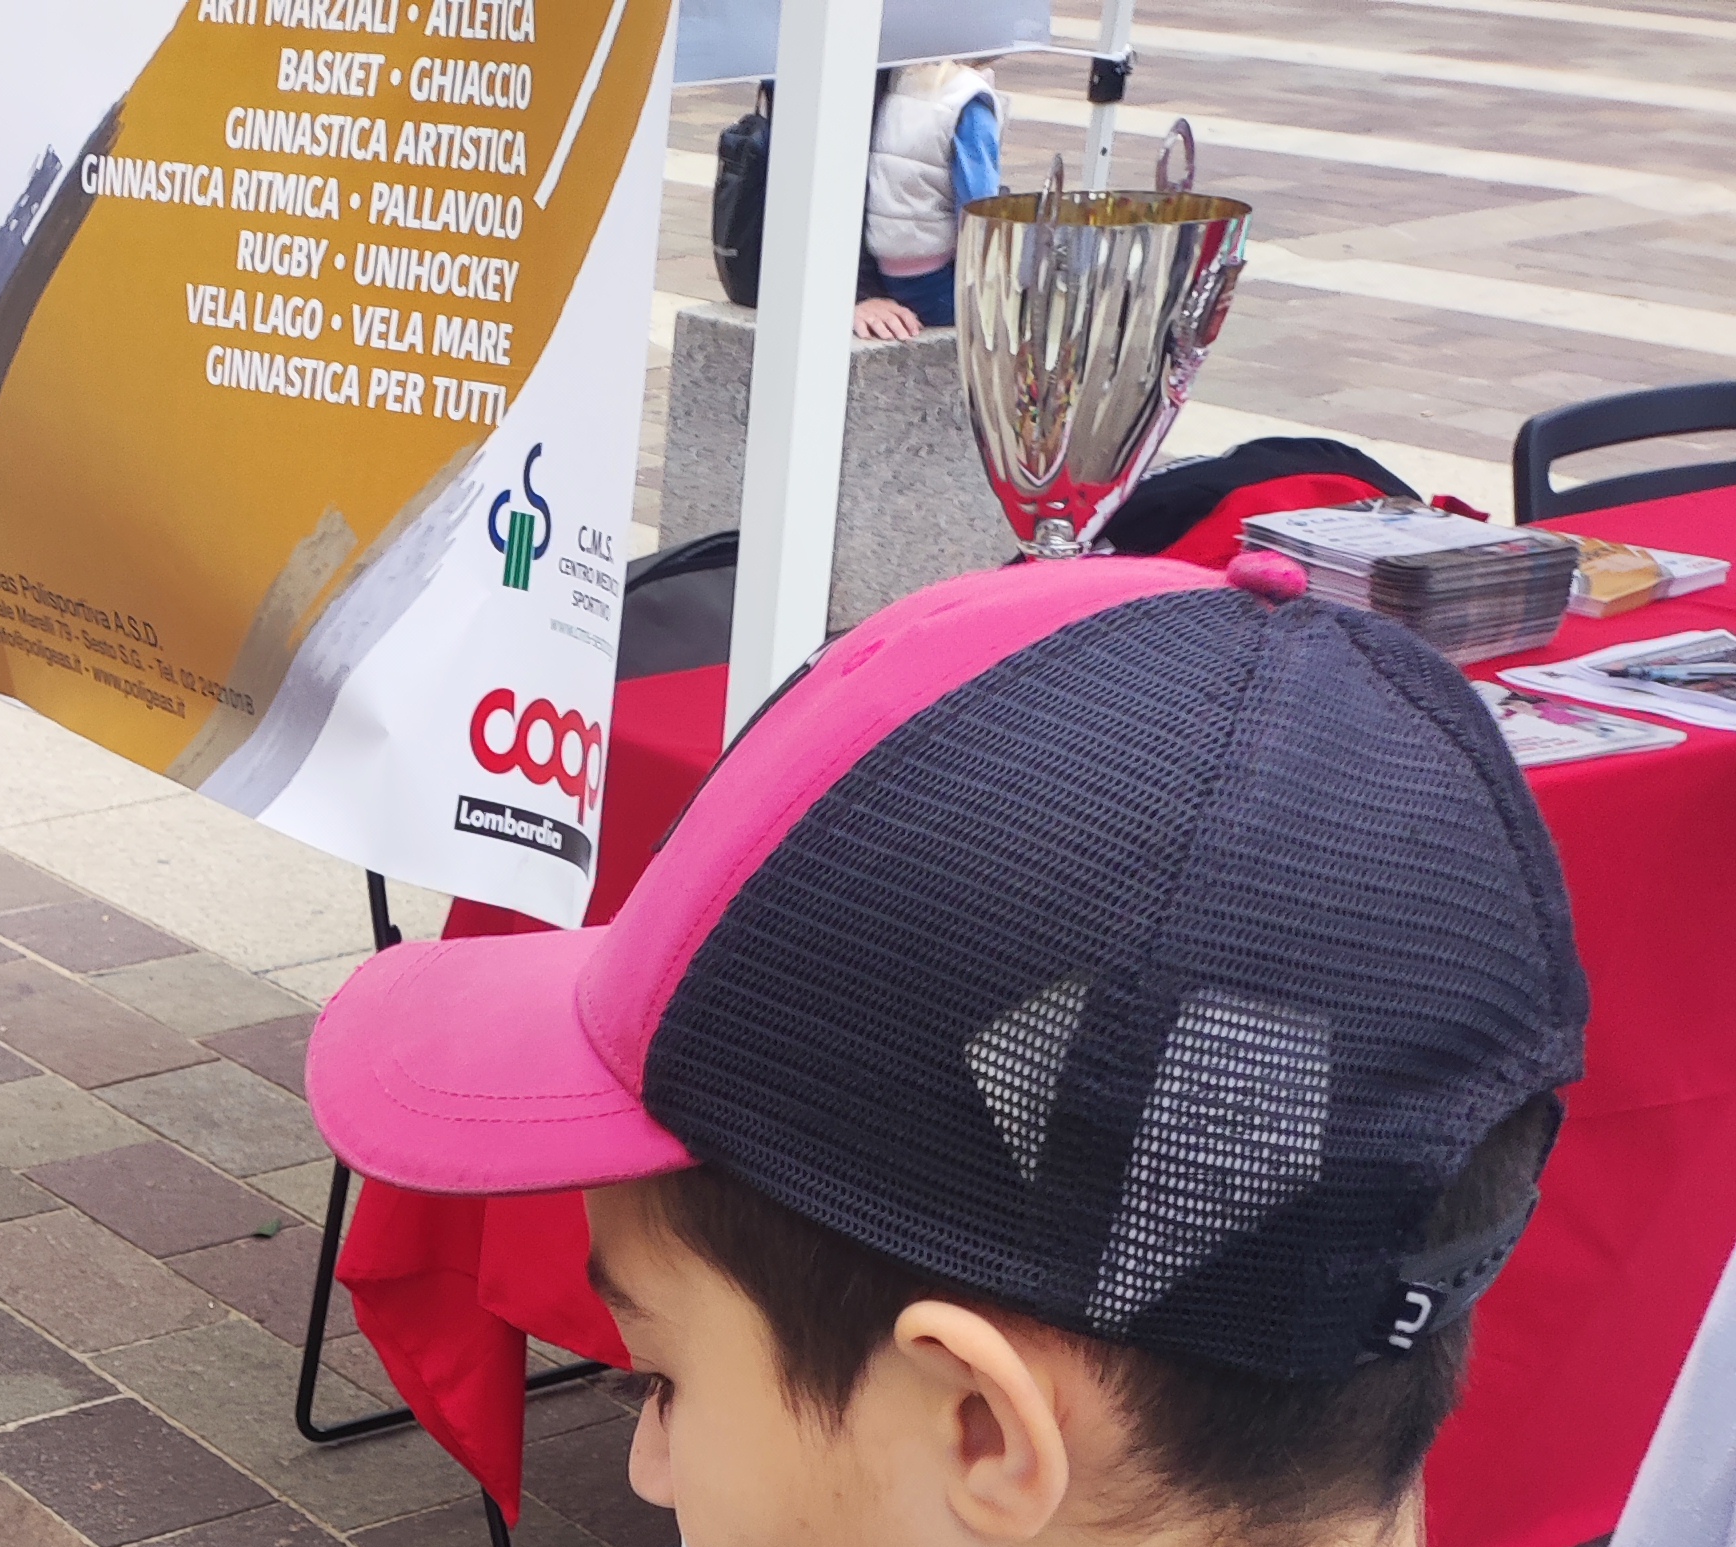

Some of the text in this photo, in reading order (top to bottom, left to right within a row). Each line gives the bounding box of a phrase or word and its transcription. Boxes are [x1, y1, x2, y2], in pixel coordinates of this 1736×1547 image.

[264, 0, 397, 34] MARZIALI
[424, 0, 536, 42] ATLETICA
[277, 48, 532, 110] BASKET GHIACCIO
[225, 107, 527, 176] GINNASTICA ARTISTICA
[81, 154, 523, 240] GINNASTICA RITMICA PALLAVOLO
[237, 230, 519, 302] RUGBY UNIHOCKEY
[186, 283, 513, 365] VELA LAGO VELA MARE
[206, 345, 508, 428] GINNASTICA PER TUTTI
[19, 574, 111, 630] Polisportiva
[470, 688, 602, 826] coop
[459, 800, 563, 850] Lombardia
